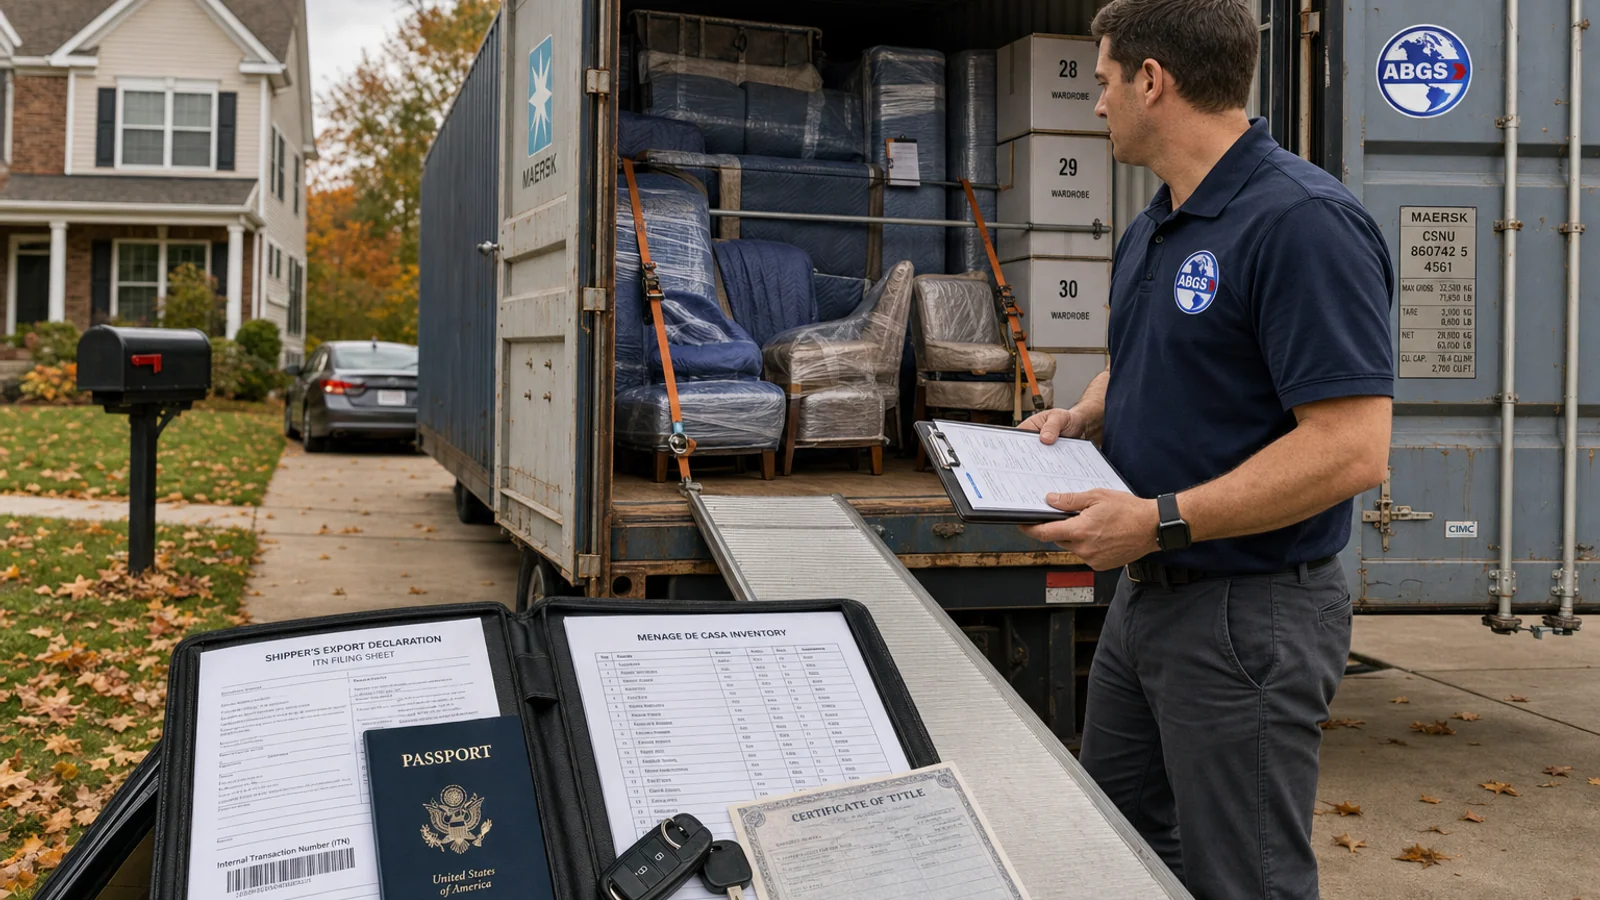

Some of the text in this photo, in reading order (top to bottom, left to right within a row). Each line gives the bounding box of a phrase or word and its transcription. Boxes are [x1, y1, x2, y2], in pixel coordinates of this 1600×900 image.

[1059, 59, 1077, 78] 28
[1383, 62, 1448, 80] ABGS
[1051, 92, 1090, 100] WARDROBE
[522, 152, 557, 190] MAERSK
[1059, 158, 1078, 176] 29
[1051, 190, 1090, 199] WARDROBE
[1411, 212, 1468, 223] MAERSK
[1422, 230, 1455, 242] CSNU
[1411, 246, 1468, 256] 860742 5
[1424, 262, 1452, 272] 4561
[1178, 274, 1207, 290] ABGS
[1402, 284, 1415, 292] MAX
[1416, 284, 1434, 292] GROSS
[1059, 280, 1078, 298] 30
[1464, 294, 1472, 302] LB
[1051, 312, 1090, 320] WARDROBE
[1402, 308, 1418, 316] TARE
[1464, 318, 1472, 326] LB
[1402, 331, 1414, 339] NET
[1448, 525, 1474, 533] CIMC
[637, 629, 786, 641] MENAGE DE CASA INVENTORY
[265, 635, 442, 662] SHIPPER'S EXPORT DECLARATION
[331, 654, 363, 664] FILING
[365, 651, 395, 660] SHEET
[401, 745, 492, 767] PASSPORT
[792, 788, 926, 823] CERTIFICATE OF TITLE
[217, 837, 350, 869] Internal Transaction Number (ITN)
[432, 868, 495, 884] United States
[440, 880, 492, 898] of America
